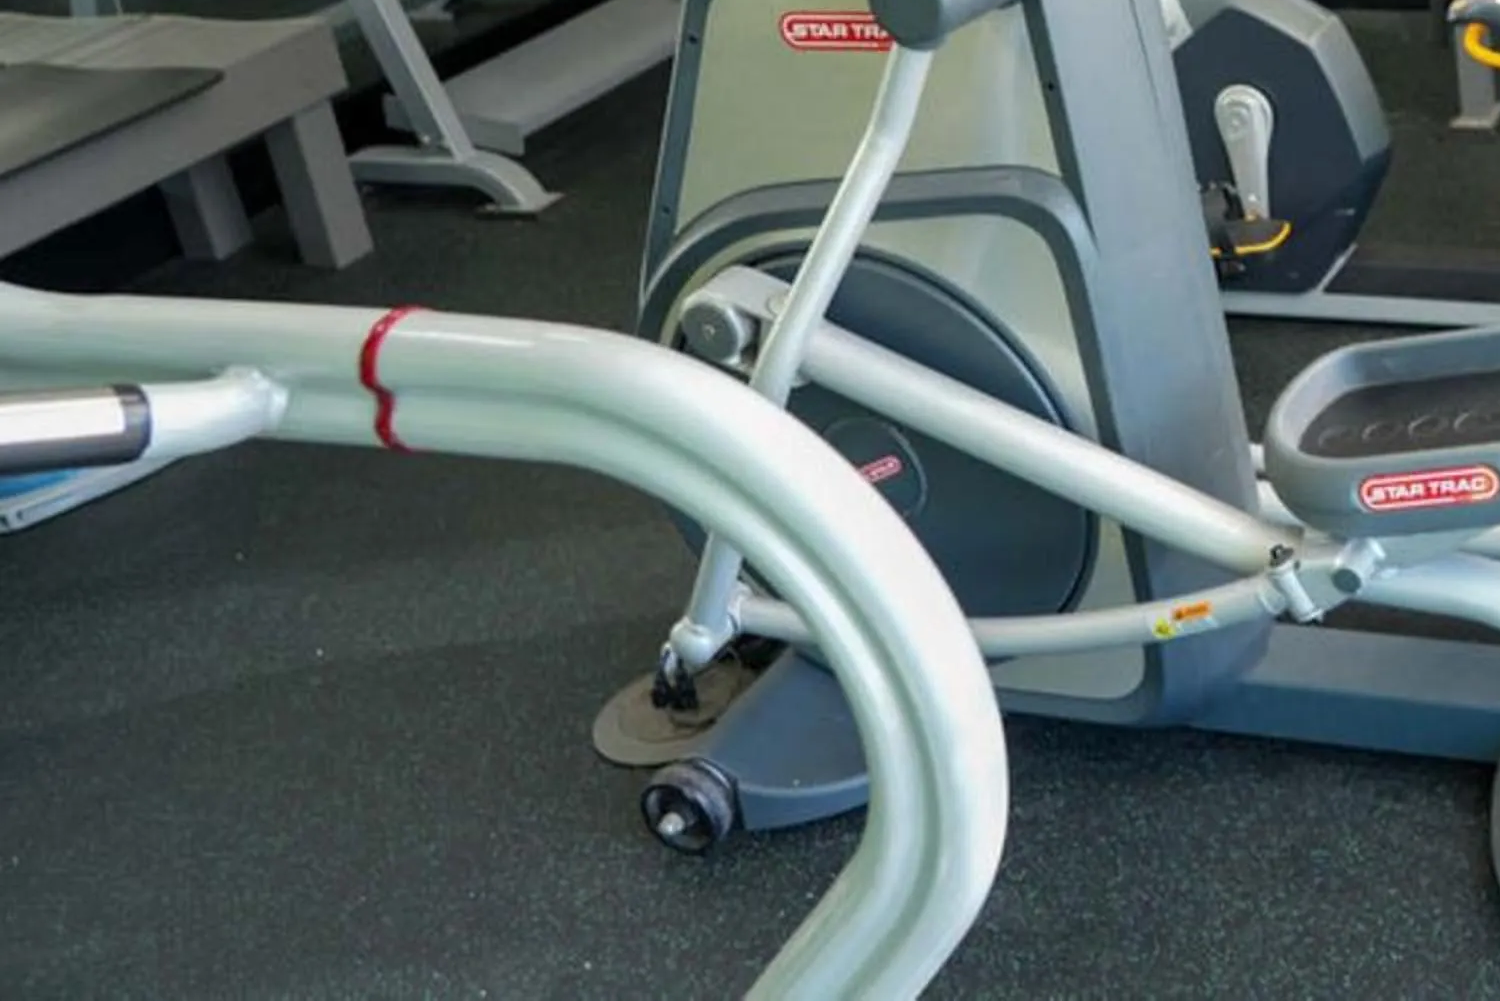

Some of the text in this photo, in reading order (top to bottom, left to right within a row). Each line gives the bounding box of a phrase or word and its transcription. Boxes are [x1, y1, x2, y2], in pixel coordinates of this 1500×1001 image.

[793, 22, 889, 39] STAR TR
[1370, 483, 1425, 503] STAR
